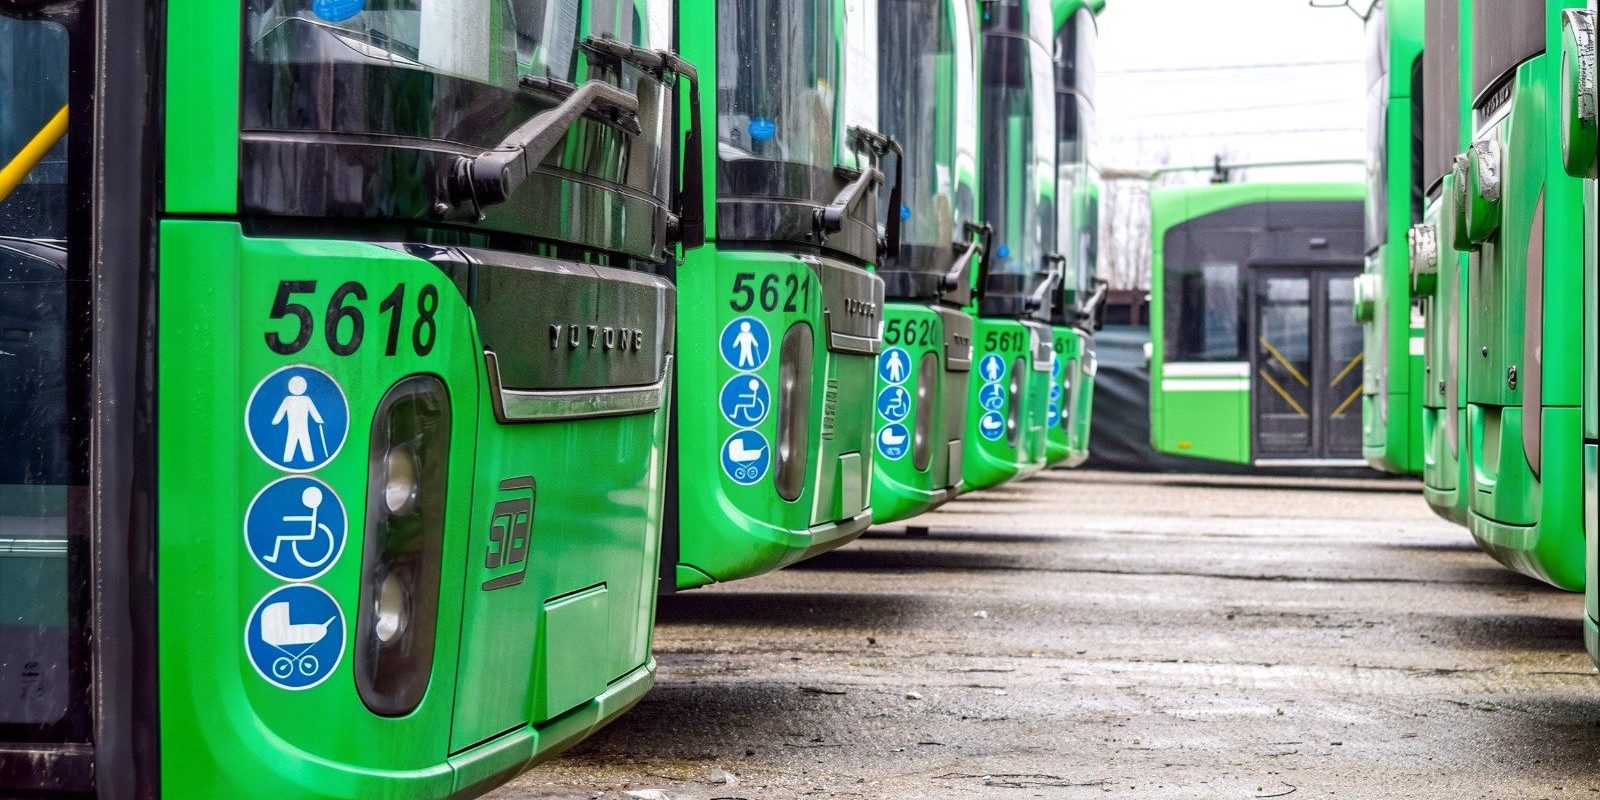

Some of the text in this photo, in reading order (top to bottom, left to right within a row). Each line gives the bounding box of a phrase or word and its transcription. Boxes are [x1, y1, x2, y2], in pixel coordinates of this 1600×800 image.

[729, 272, 811, 314] 5621
[264, 279, 439, 357] 5618
[550, 324, 643, 351] YUTONG
